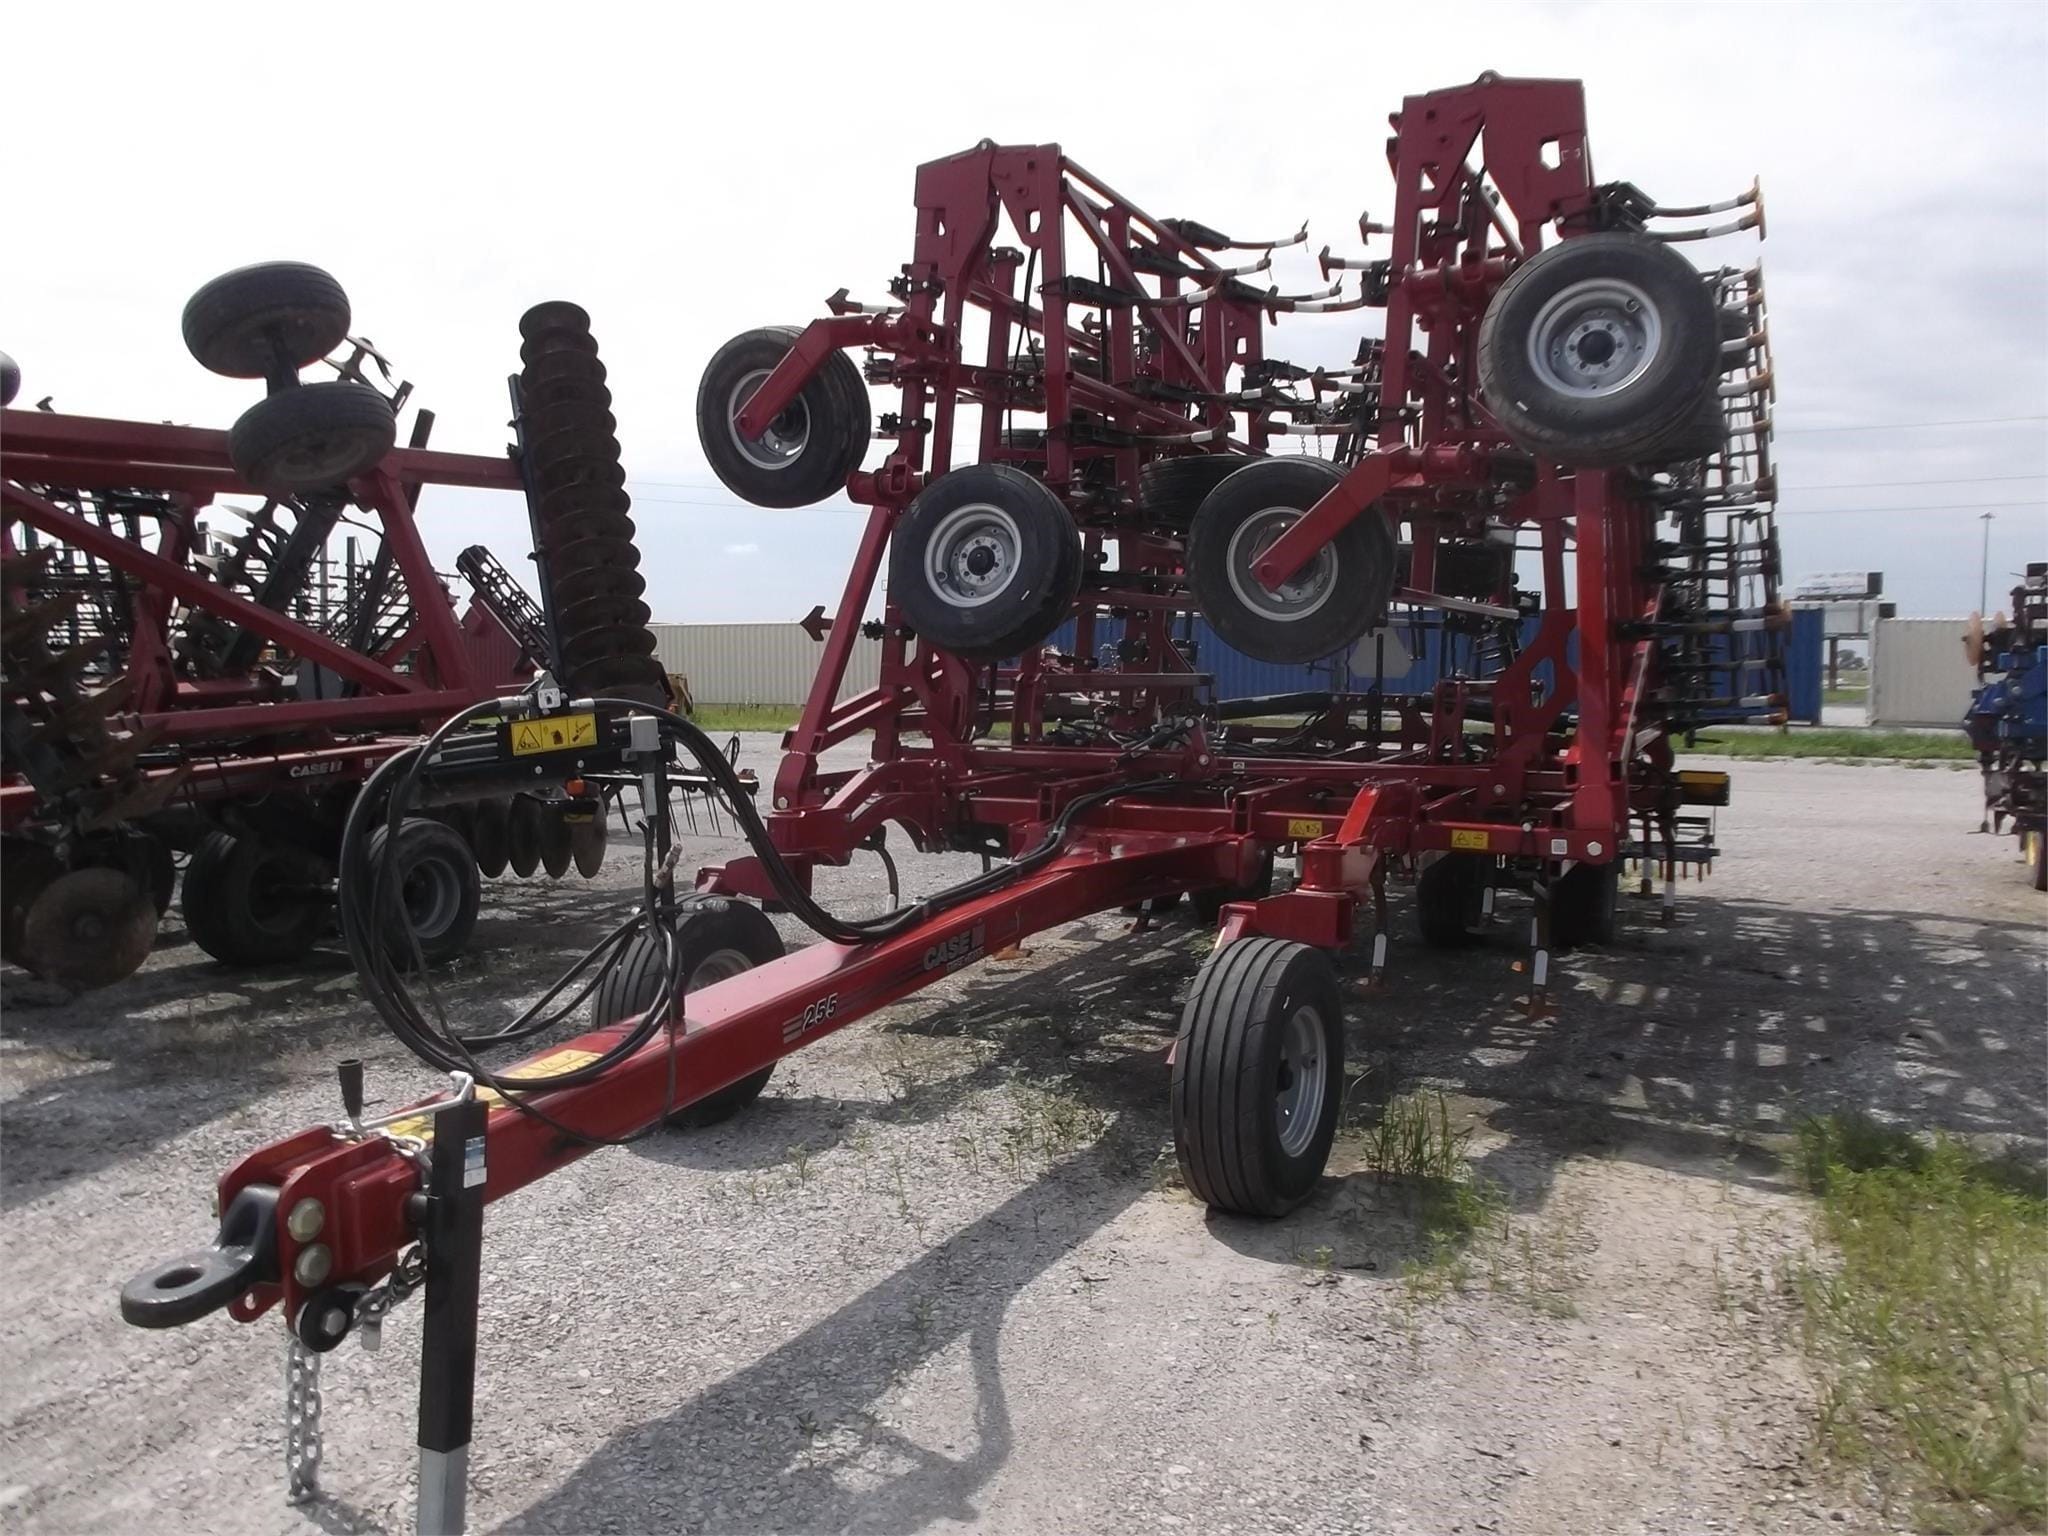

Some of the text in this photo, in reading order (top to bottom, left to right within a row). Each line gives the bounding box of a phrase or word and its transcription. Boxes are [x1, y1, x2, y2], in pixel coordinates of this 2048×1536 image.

[290, 762, 329, 778] CASE
[923, 929, 970, 971] CASE
[802, 992, 838, 1032] 255
